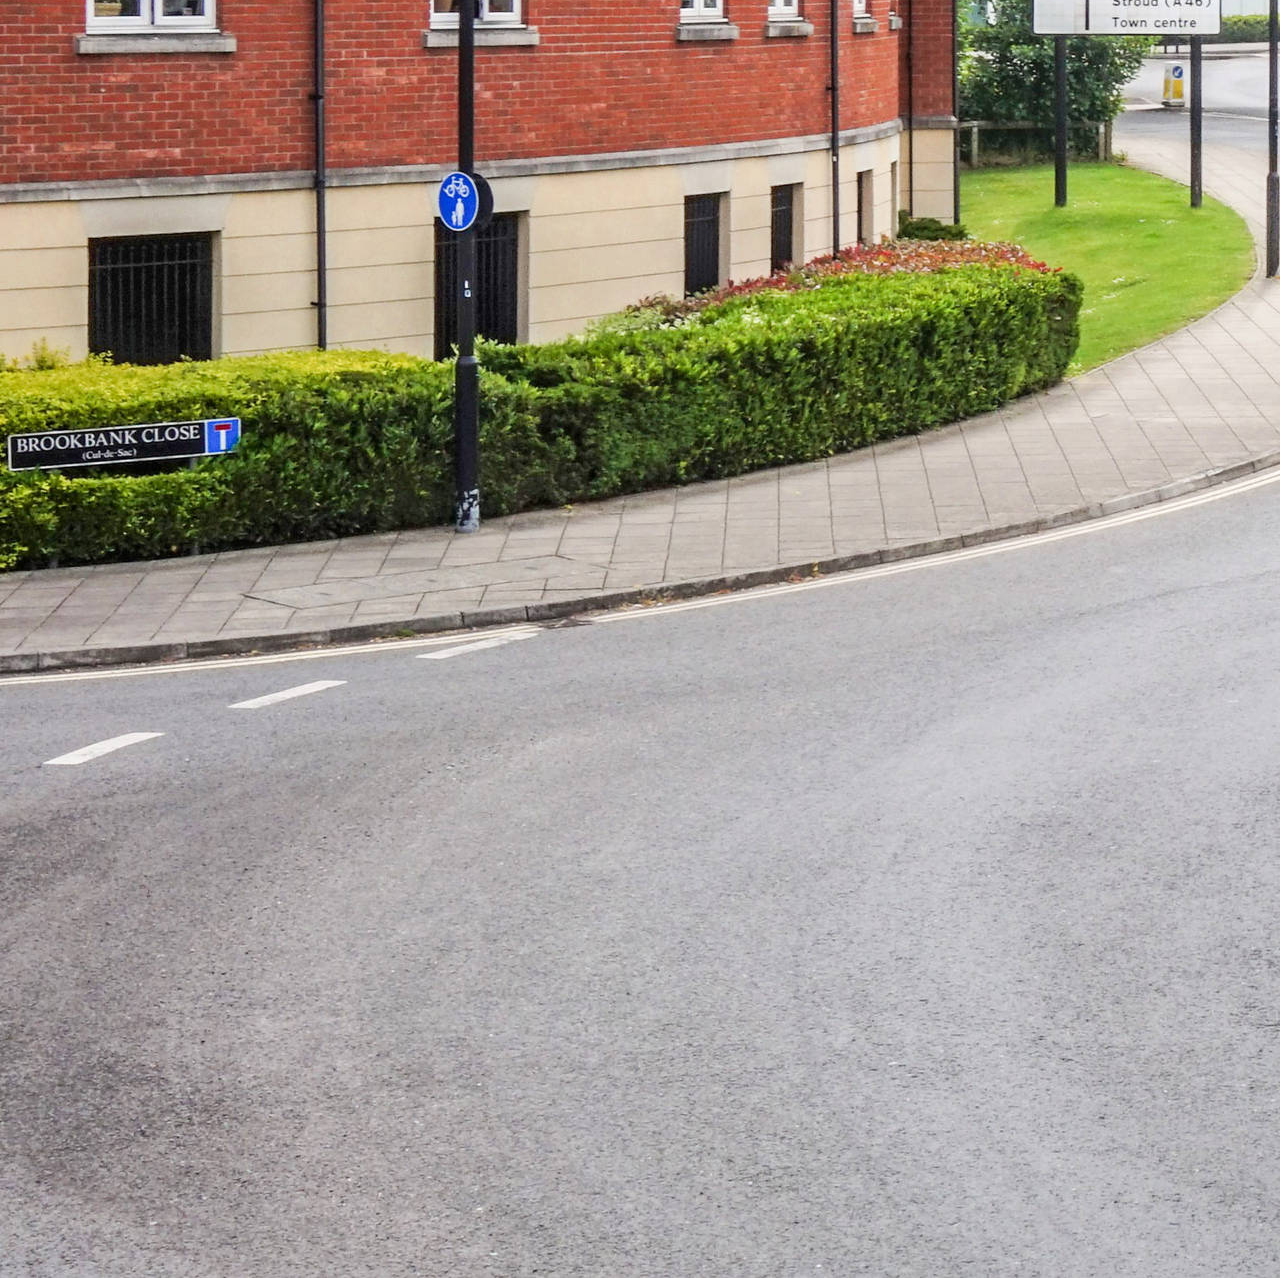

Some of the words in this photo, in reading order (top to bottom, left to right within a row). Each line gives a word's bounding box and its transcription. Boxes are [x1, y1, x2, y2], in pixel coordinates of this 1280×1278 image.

[1112, 17, 1147, 28] Town
[1154, 18, 1197, 28] centre
[16, 430, 138, 453] BROOKBANK
[141, 424, 201, 443] CLOSE
[82, 448, 137, 461] (Cul-de-Sac)
